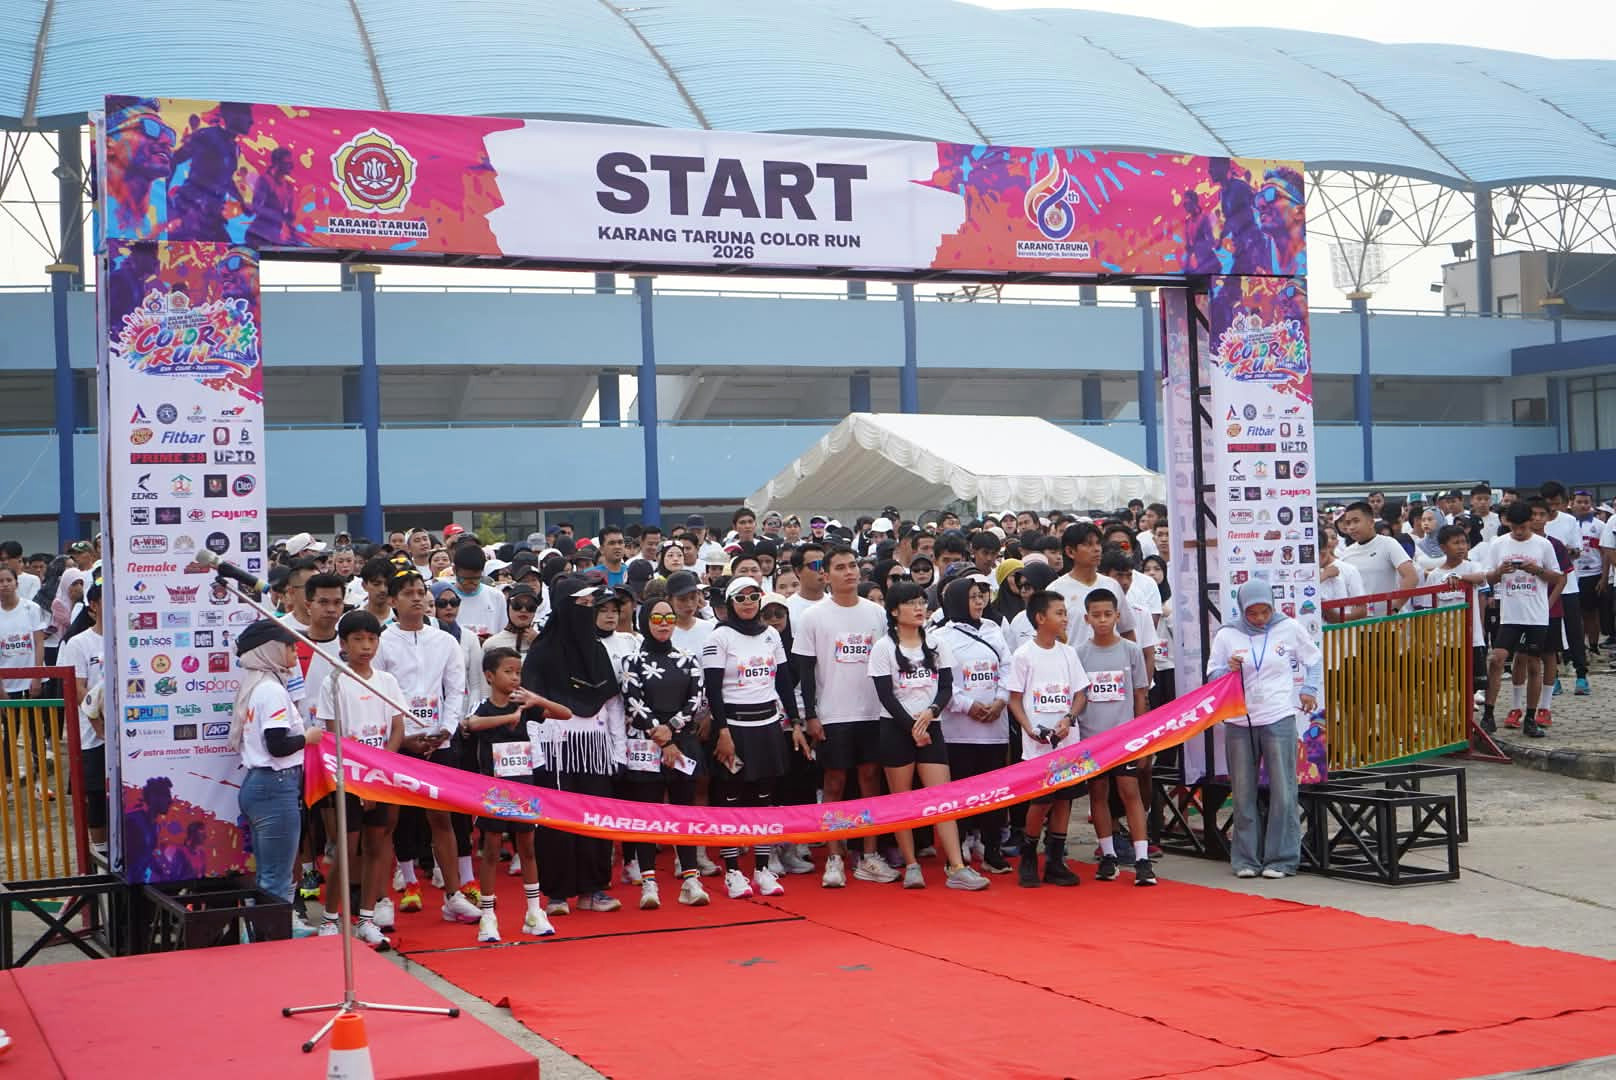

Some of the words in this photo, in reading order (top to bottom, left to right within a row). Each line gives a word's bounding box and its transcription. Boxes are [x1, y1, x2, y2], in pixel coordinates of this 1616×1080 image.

[596, 151, 868, 222] START
[329, 218, 377, 228] KARANG
[379, 220, 427, 230] TARUNA
[329, 227, 376, 235] KABUPATEN
[598, 226, 677, 242] KARANG
[682, 229, 755, 245] TARUNA
[760, 232, 819, 247] COLOR
[825, 234, 861, 248] RUN
[1017, 242, 1054, 250] KARANG
[1055, 243, 1089, 251] TARUNA
[713, 245, 754, 259] 2026
[136, 325, 216, 353] COLOR
[152, 345, 209, 365] RUN
[1229, 341, 1280, 363] COLOR
[1240, 357, 1276, 373] RUN
[1246, 425, 1275, 436] Fitbar
[161, 431, 206, 444] Fitbar
[1227, 530, 1260, 539] Remake
[132, 538, 166, 546] A-WING
[127, 561, 177, 573] Remake
[842, 645, 867, 654] 0382
[745, 667, 769, 677] 0675
[906, 669, 930, 679] 0269
[971, 673, 993, 681] 0061
[1093, 684, 1117, 693] 0521
[1040, 694, 1067, 704] 0460
[404, 709, 433, 719] 689
[501, 757, 527, 767] 0638
[583, 812, 679, 833] HARBAK
[688, 822, 784, 835] KARANG
